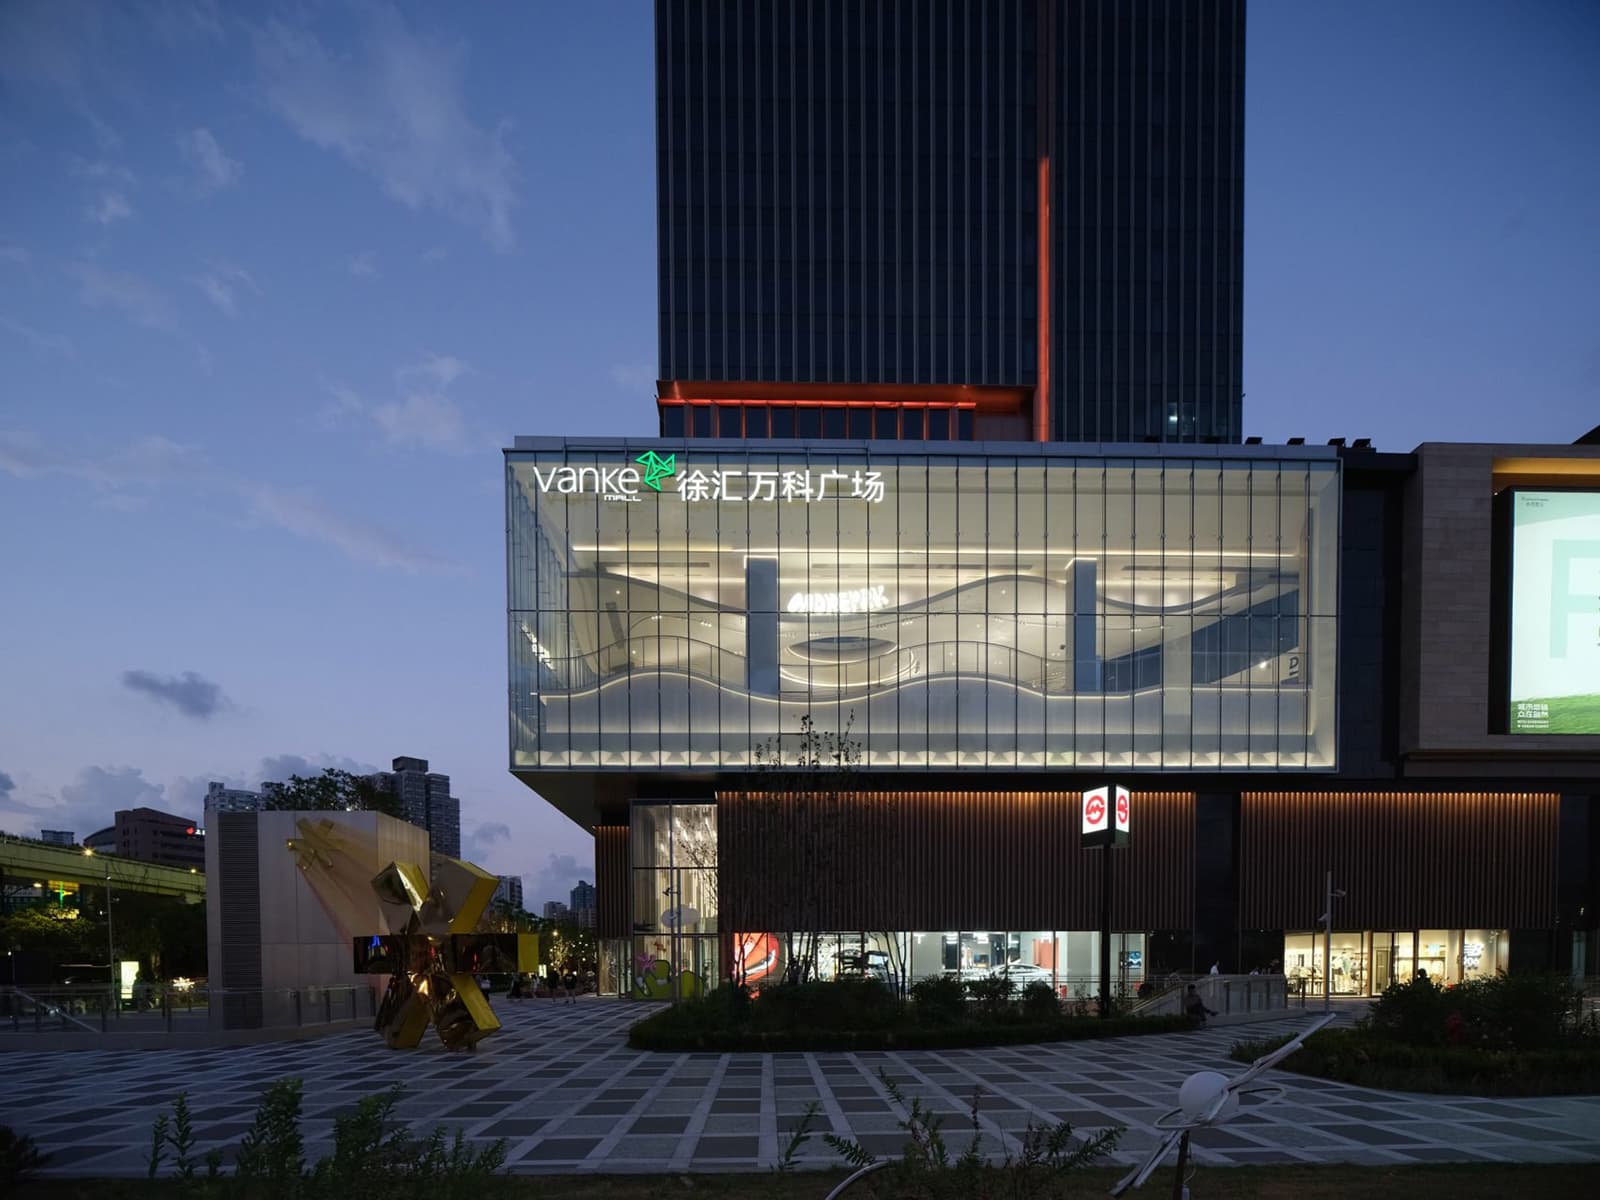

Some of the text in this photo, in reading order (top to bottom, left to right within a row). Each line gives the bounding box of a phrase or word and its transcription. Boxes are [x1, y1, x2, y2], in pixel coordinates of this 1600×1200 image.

[676, 469, 885, 503] 徐汇万科广场
